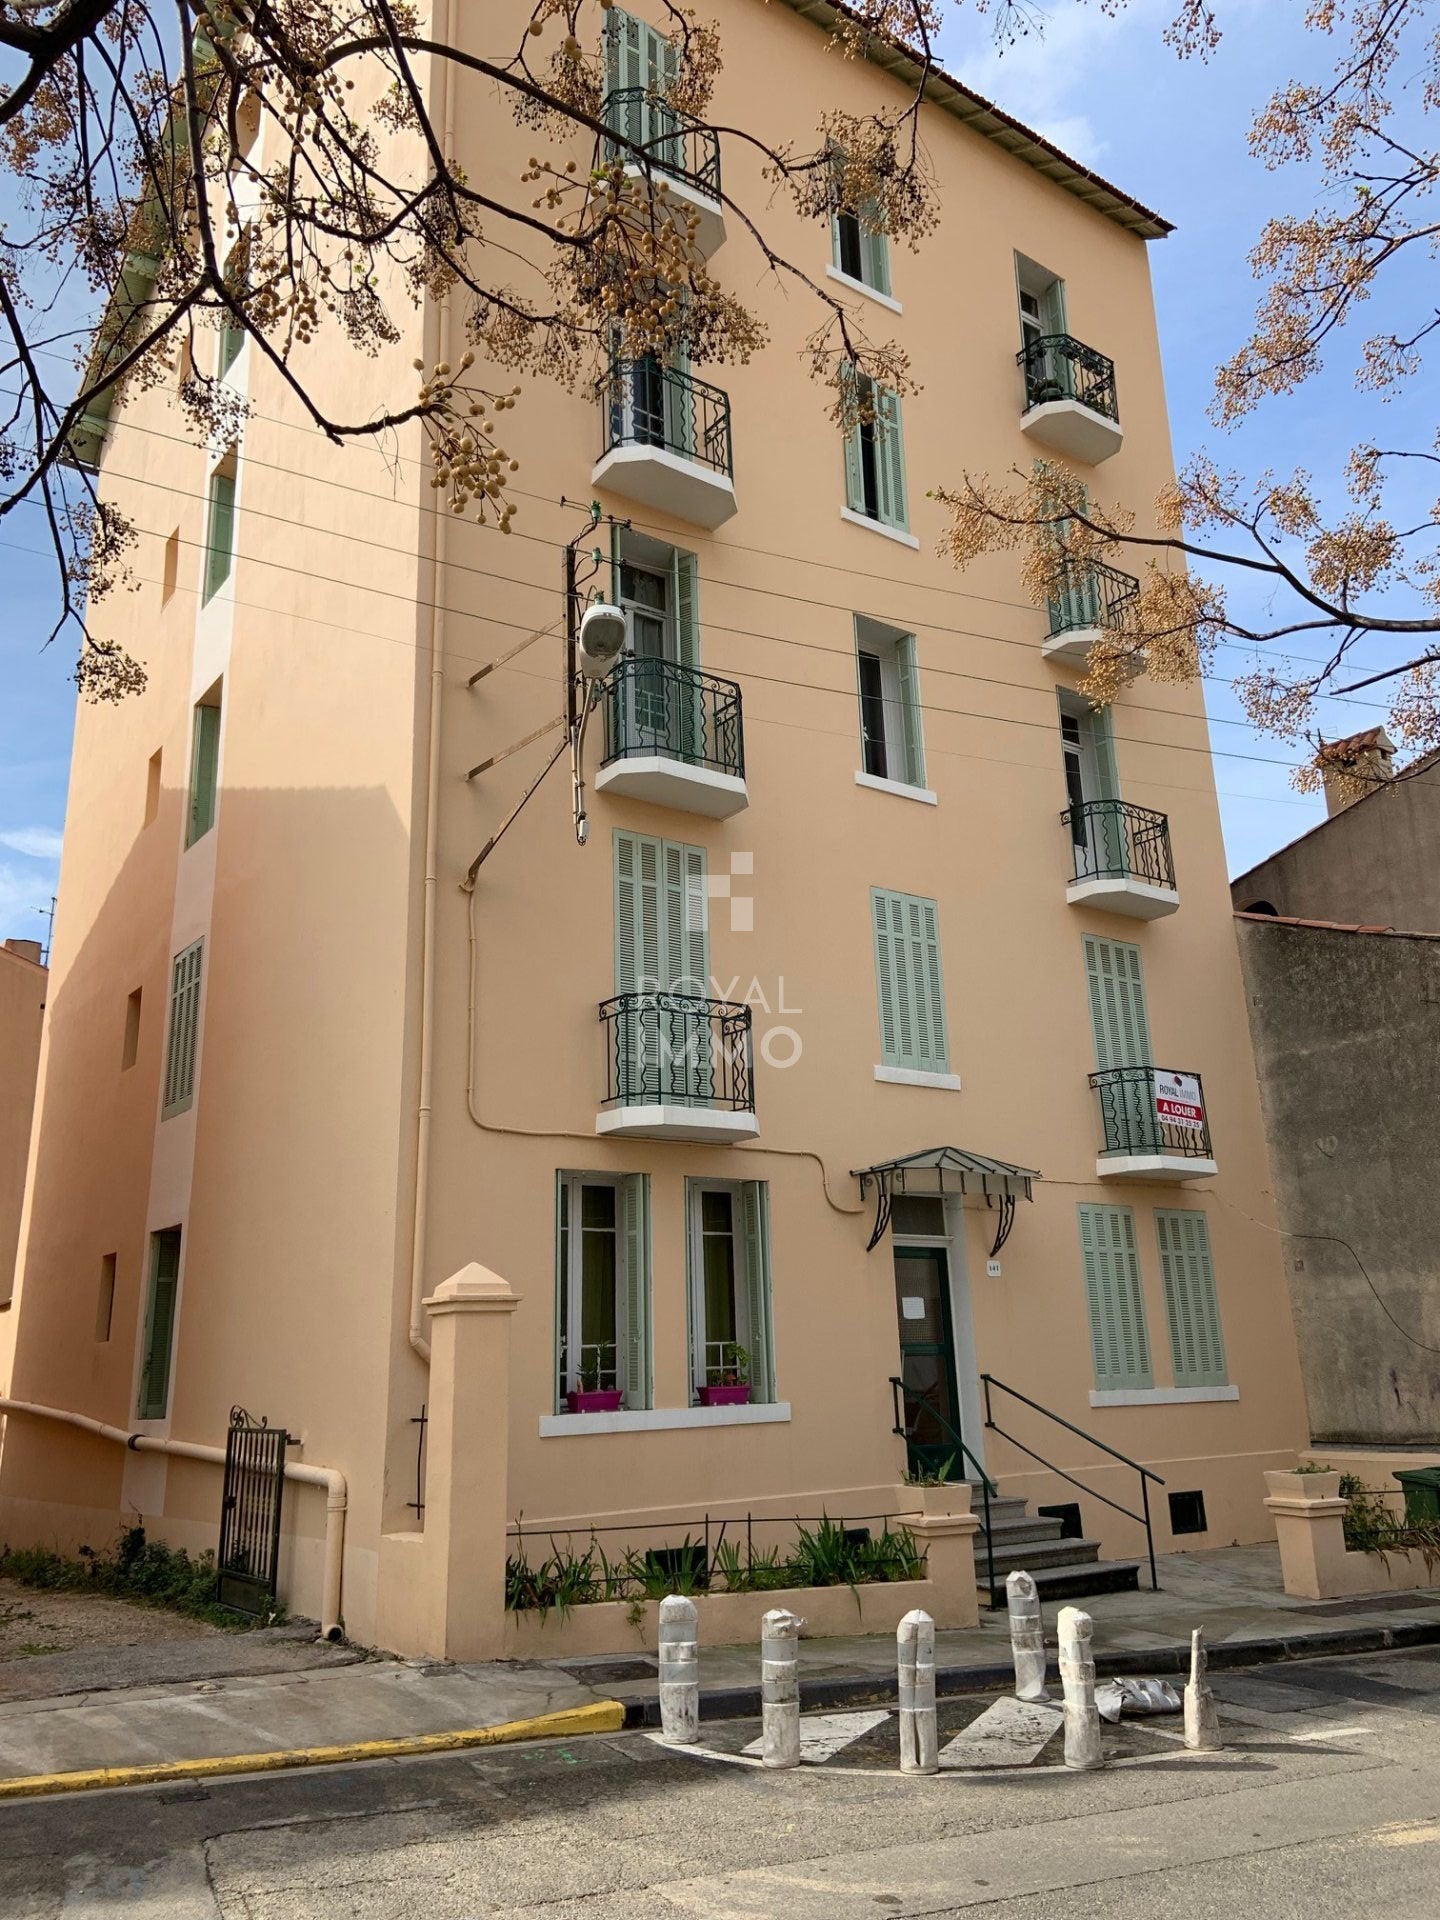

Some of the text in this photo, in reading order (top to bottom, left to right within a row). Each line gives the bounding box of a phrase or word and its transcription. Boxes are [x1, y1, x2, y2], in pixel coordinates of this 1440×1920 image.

[1159, 1084, 1179, 1097] ROYAL
[1163, 1102, 1196, 1118] A LOUER
